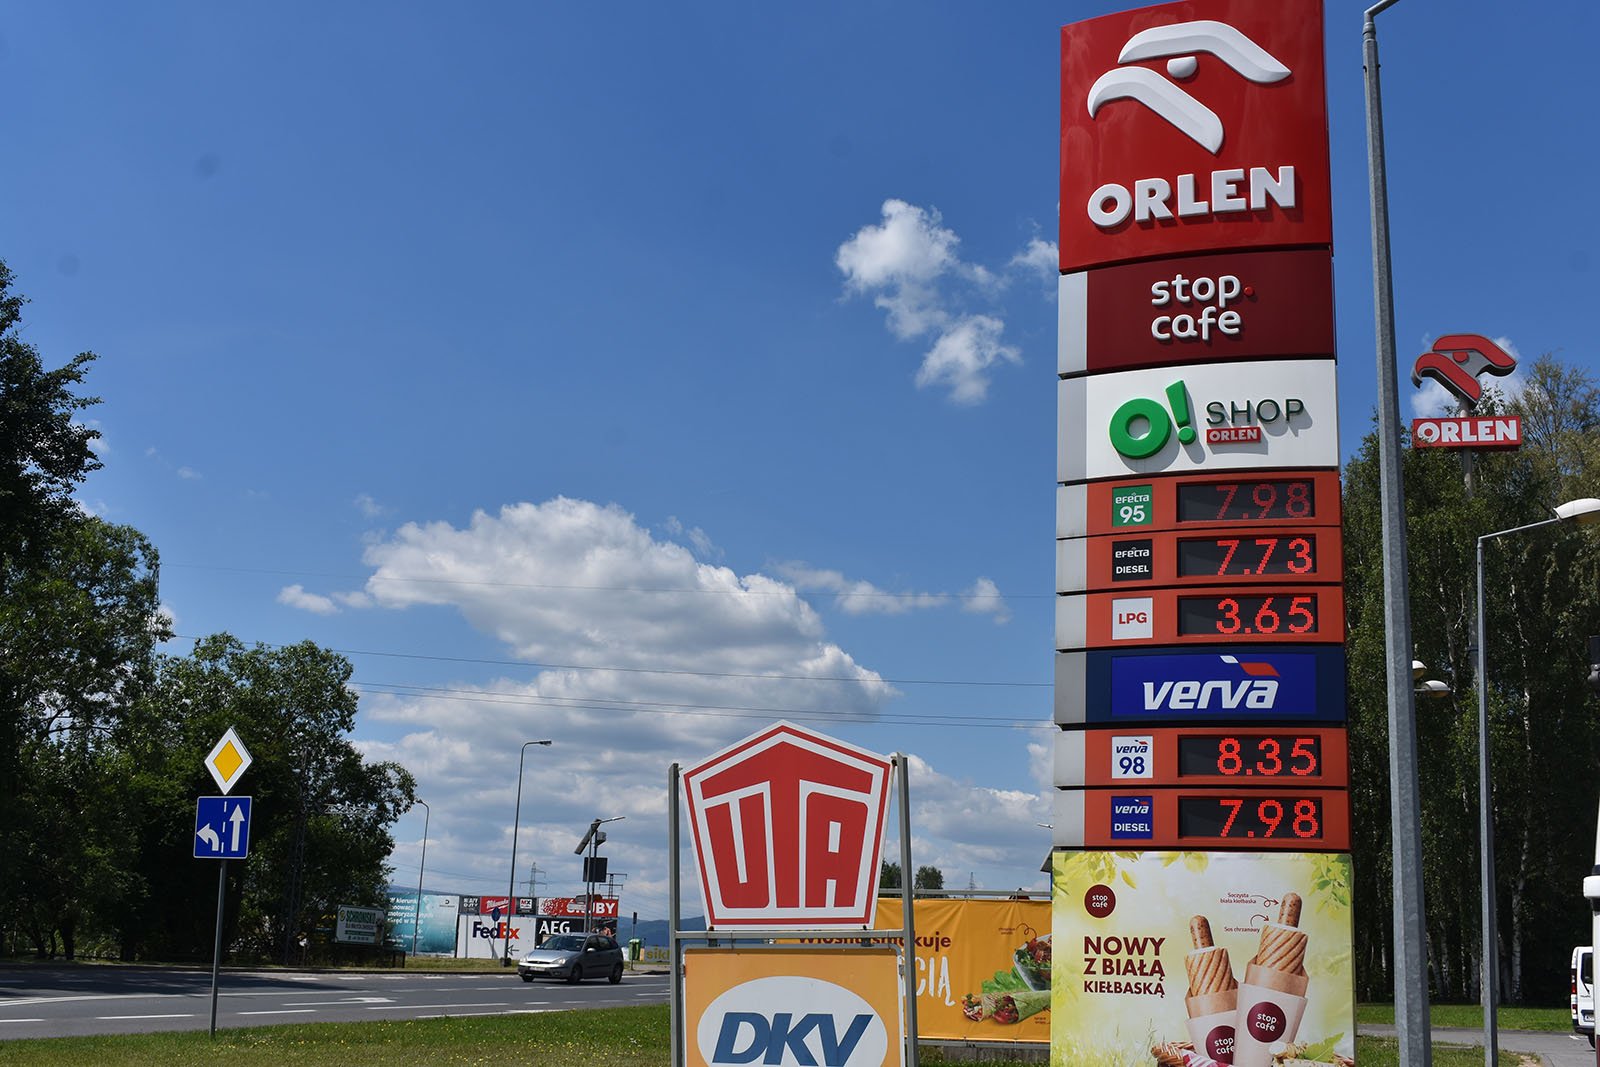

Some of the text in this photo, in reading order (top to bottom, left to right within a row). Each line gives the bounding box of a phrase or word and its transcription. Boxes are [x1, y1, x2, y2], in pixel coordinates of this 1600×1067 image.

[1087, 165, 1296, 227] ORLEN
[1151, 305, 1242, 341] cafe
[1206, 398, 1305, 425] SHOP
[1208, 429, 1259, 442] ORLEN
[1416, 419, 1518, 444] ORLEN
[1215, 483, 1311, 520] 7.98
[1119, 505, 1146, 524] 95
[1216, 537, 1313, 576] 7.73
[1115, 564, 1149, 575] DIESEL
[1118, 612, 1148, 625] LPG
[1216, 597, 1314, 634] 3.65
[1143, 680, 1279, 711] verva
[1116, 744, 1149, 754] verva
[1216, 738, 1317, 776] 8.35
[1119, 756, 1146, 775] 98
[1115, 804, 1150, 814] verva
[1219, 799, 1319, 838] 7.98
[700, 741, 874, 909] UTA
[1114, 822, 1151, 832] DIESEL
[1091, 900, 1109, 908] cafe
[1092, 894, 1109, 902] stop
[472, 921, 520, 940] FedEx
[539, 920, 571, 934] AEG
[1084, 936, 1166, 956] NOWY
[1083, 957, 1165, 982] Z BIAŁĄ
[1084, 980, 1165, 999] KIEŁBASKĄ
[1255, 1021, 1276, 1032] cafe
[1256, 1013, 1277, 1025] stop
[712, 1011, 874, 1067] DKV
[1214, 1037, 1234, 1047] stop
